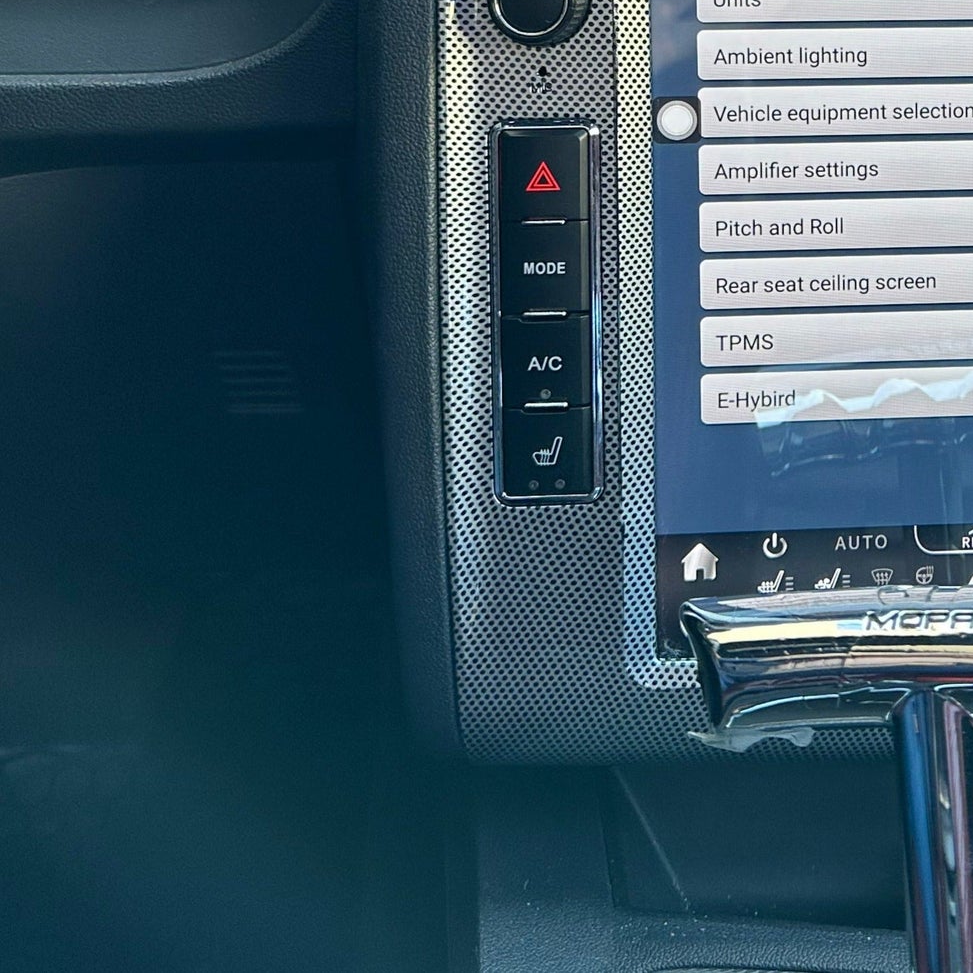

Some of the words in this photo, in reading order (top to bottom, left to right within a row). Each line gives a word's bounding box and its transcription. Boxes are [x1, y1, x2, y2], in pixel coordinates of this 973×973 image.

[713, 46, 795, 66] Ambient
[798, 45, 868, 69] lighting
[712, 103, 783, 123] Vehicle
[786, 103, 888, 127] equipment
[714, 160, 801, 184] Amplifier
[804, 159, 880, 182] settings
[714, 217, 764, 237] Pitch
[768, 218, 805, 237] and
[809, 216, 845, 236] Roll
[522, 261, 567, 276] MODE
[715, 275, 760, 295] Rear
[762, 275, 806, 294] seat
[808, 273, 871, 296] ceiling
[874, 273, 938, 291] screen
[715, 332, 775, 353] TPMS
[527, 354, 564, 372] A/C
[717, 389, 796, 414] E-Hybird
[834, 533, 888, 552] AUTO
